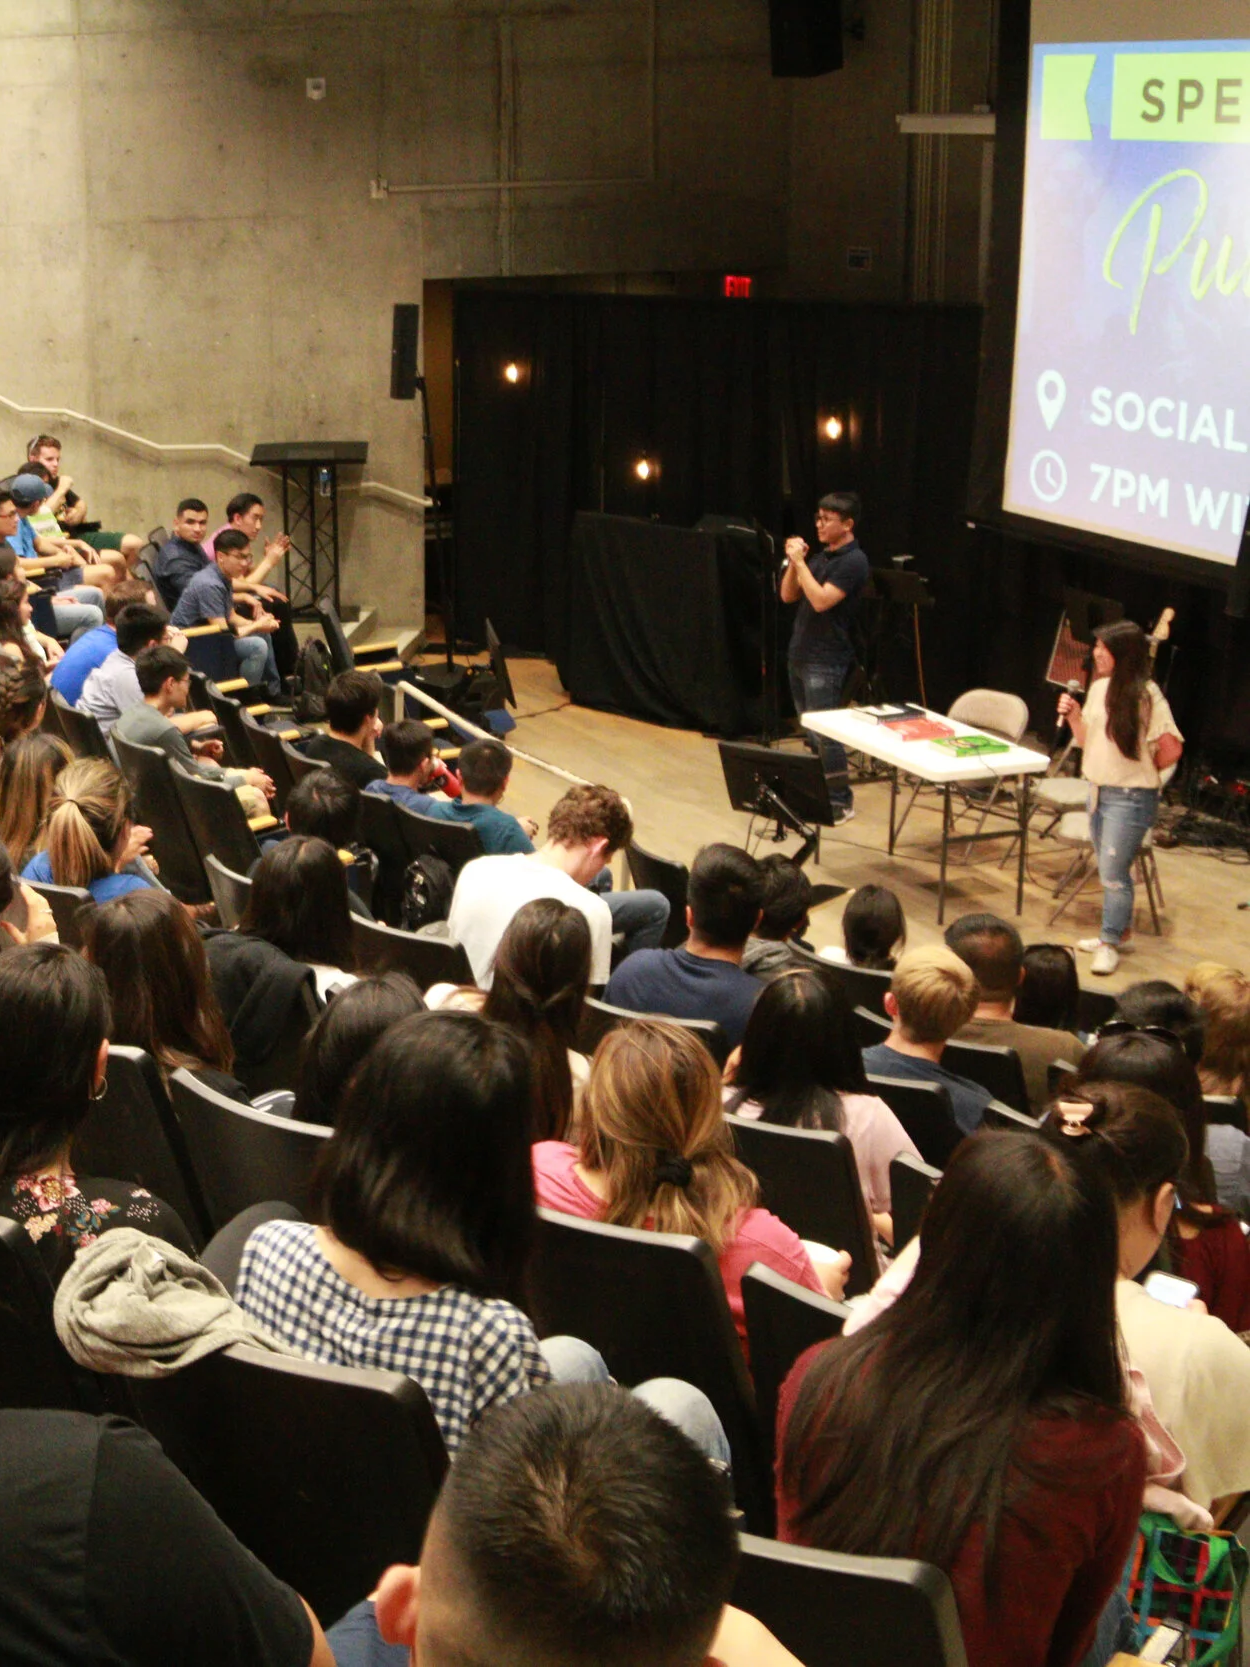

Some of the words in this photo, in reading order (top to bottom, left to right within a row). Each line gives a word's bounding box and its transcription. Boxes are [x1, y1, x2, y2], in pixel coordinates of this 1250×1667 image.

[1140, 78, 1243, 124] SPE
[1103, 168, 1250, 335] Pu
[1090, 386, 1248, 453] SOCIAL
[1090, 462, 1169, 518] 7PM
[1184, 483, 1250, 536] WI
